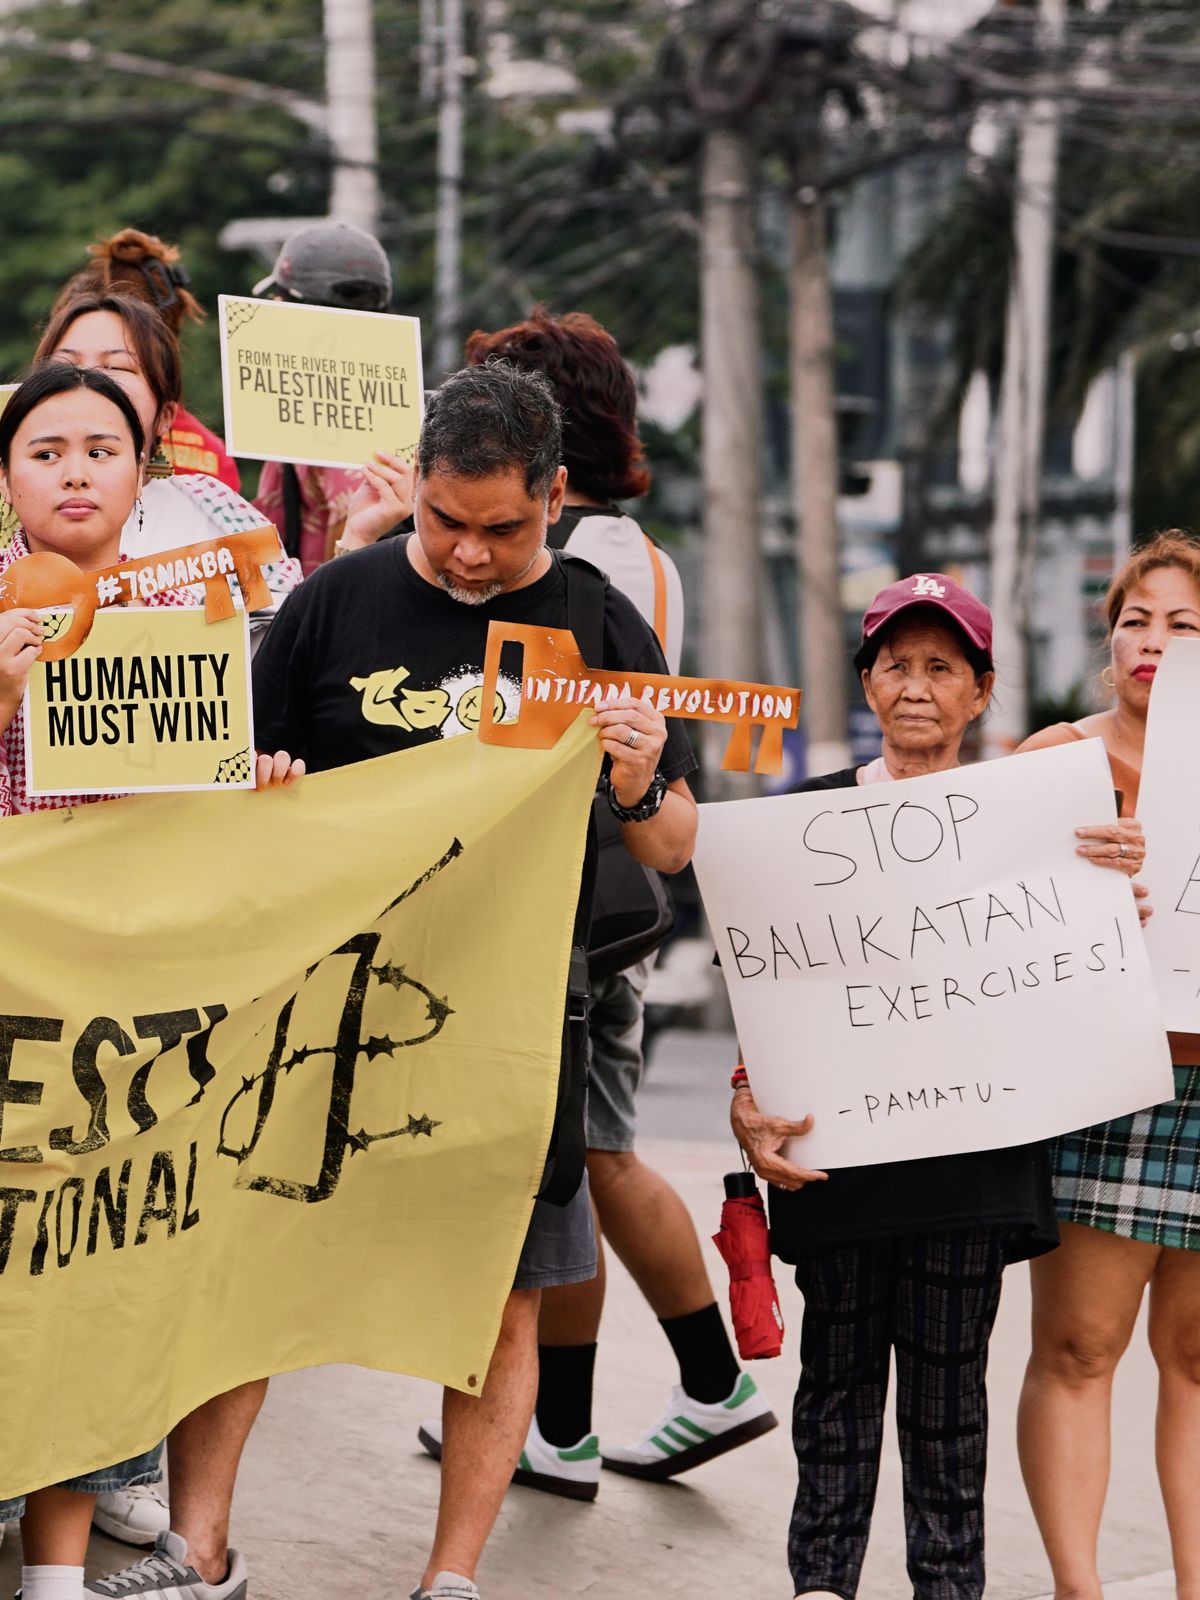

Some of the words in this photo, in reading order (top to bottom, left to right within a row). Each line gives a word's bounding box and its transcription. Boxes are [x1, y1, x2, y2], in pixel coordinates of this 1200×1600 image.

[237, 349, 272, 366] FROM
[275, 353, 297, 370] THE
[301, 356, 337, 374] RIVER
[341, 360, 355, 376] TO
[359, 362, 381, 379] THE
[385, 365, 408, 381] SEA
[239, 366, 352, 402] PALESTINE
[359, 379, 410, 408] WILL
[278, 398, 305, 425] BE
[313, 401, 374, 432] FREE!
[95, 547, 235, 606] #78NAKBA
[911, 575, 945, 598] LA
[45, 653, 230, 702] HUMANITY
[48, 703, 139, 747] MUST
[150, 701, 230, 743] WIN!
[640, 685, 793, 719] REVOLUTION
[802, 794, 979, 886] STOP
[727, 876, 1066, 980] BALIKATAN
[846, 917, 1126, 1027] EXERCISES!
